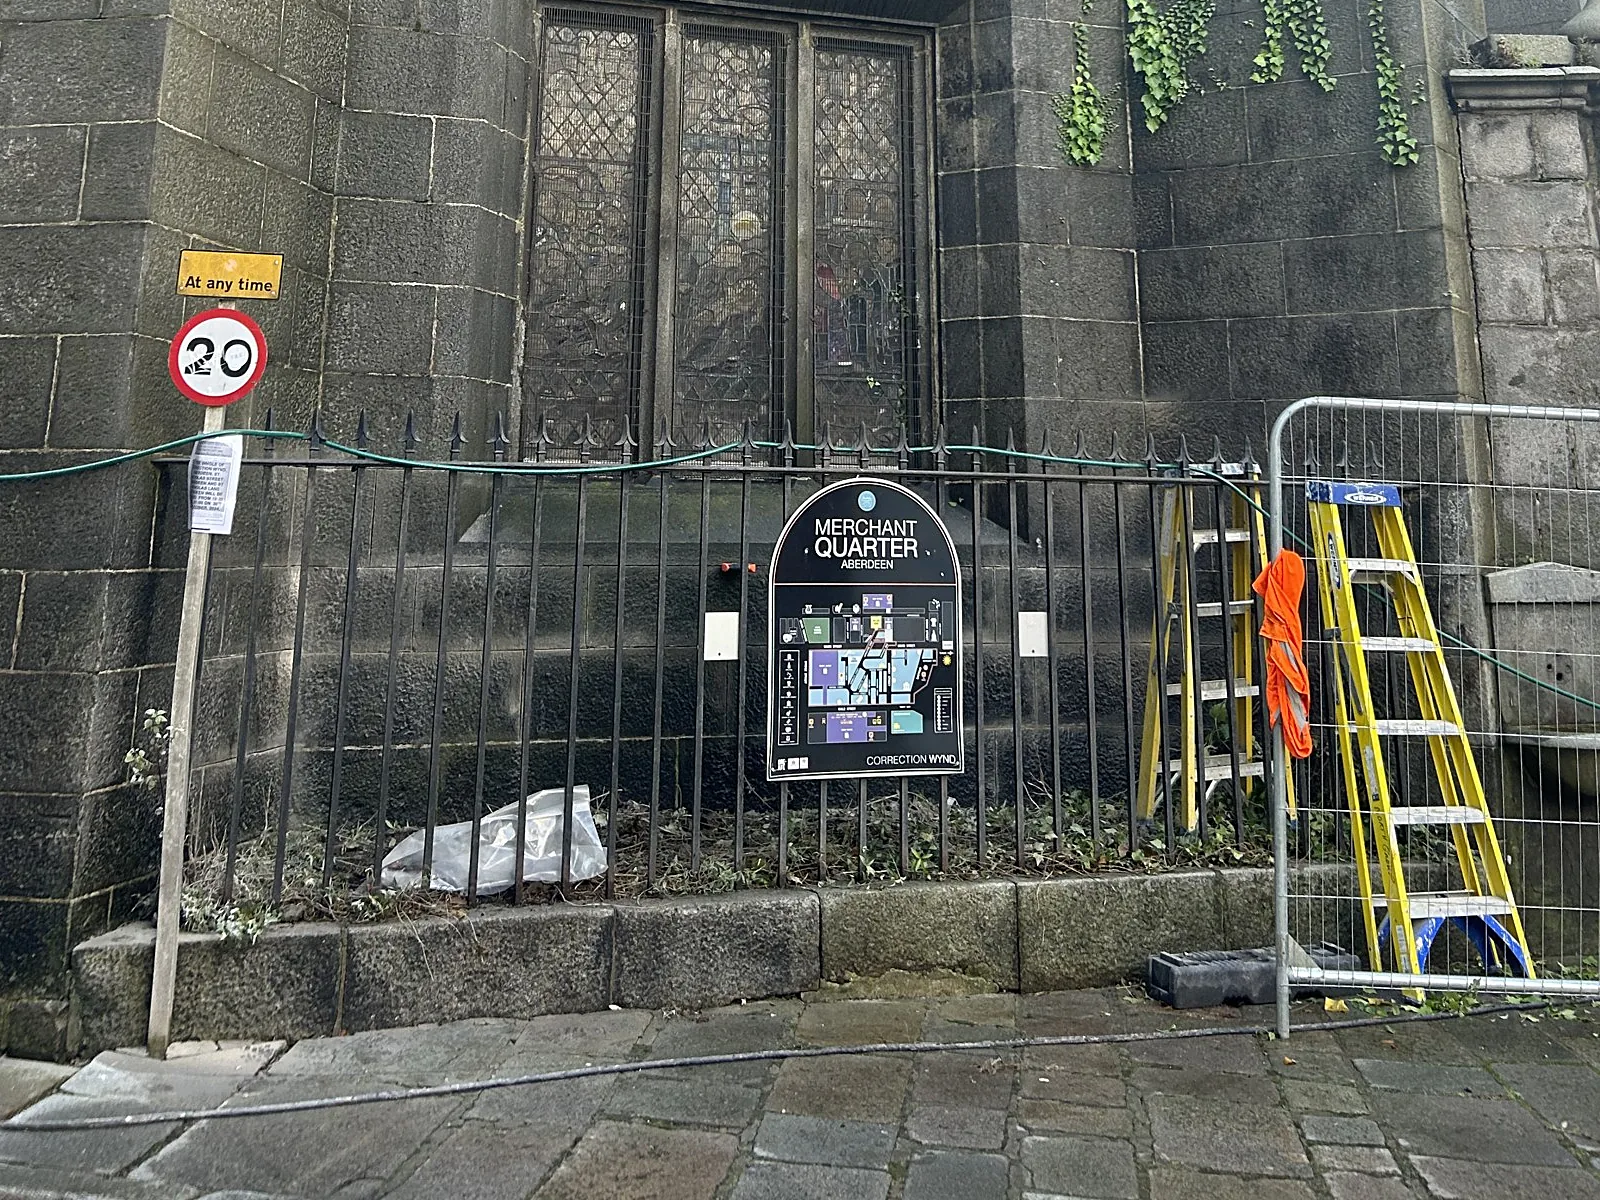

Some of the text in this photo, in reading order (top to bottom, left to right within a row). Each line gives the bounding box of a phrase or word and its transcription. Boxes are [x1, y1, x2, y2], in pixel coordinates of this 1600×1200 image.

[185, 276, 273, 292] At any time
[184, 337, 252, 378] 20
[815, 518, 918, 536] MERCHANT
[814, 536, 919, 559] QUARTER
[841, 559, 894, 569] ABERDEEN
[866, 754, 957, 766] CORRECTION WYND
